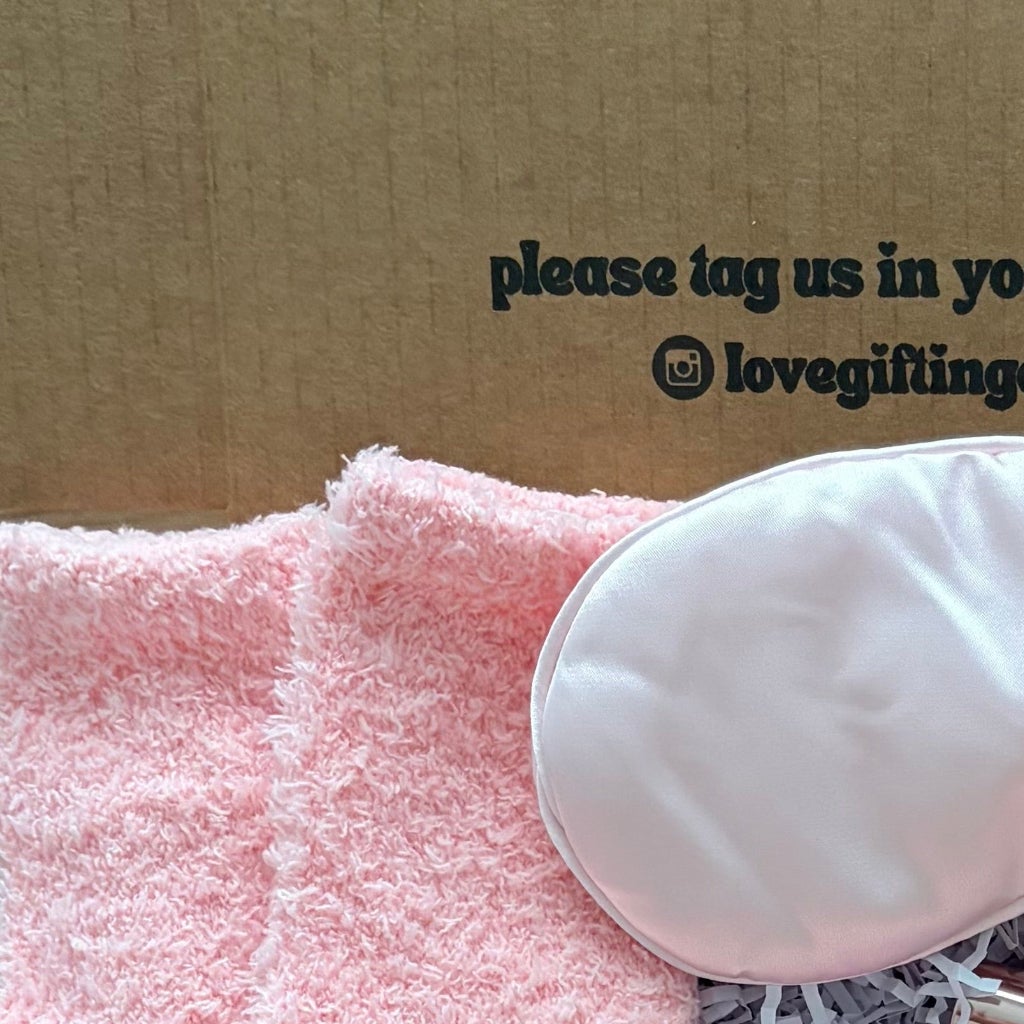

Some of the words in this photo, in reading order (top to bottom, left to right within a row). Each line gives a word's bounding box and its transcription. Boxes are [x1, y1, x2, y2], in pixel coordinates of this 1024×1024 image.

[490, 240, 678, 311] please
[690, 244, 780, 314] tag
[794, 258, 864, 298] us
[877, 241, 940, 298] in
